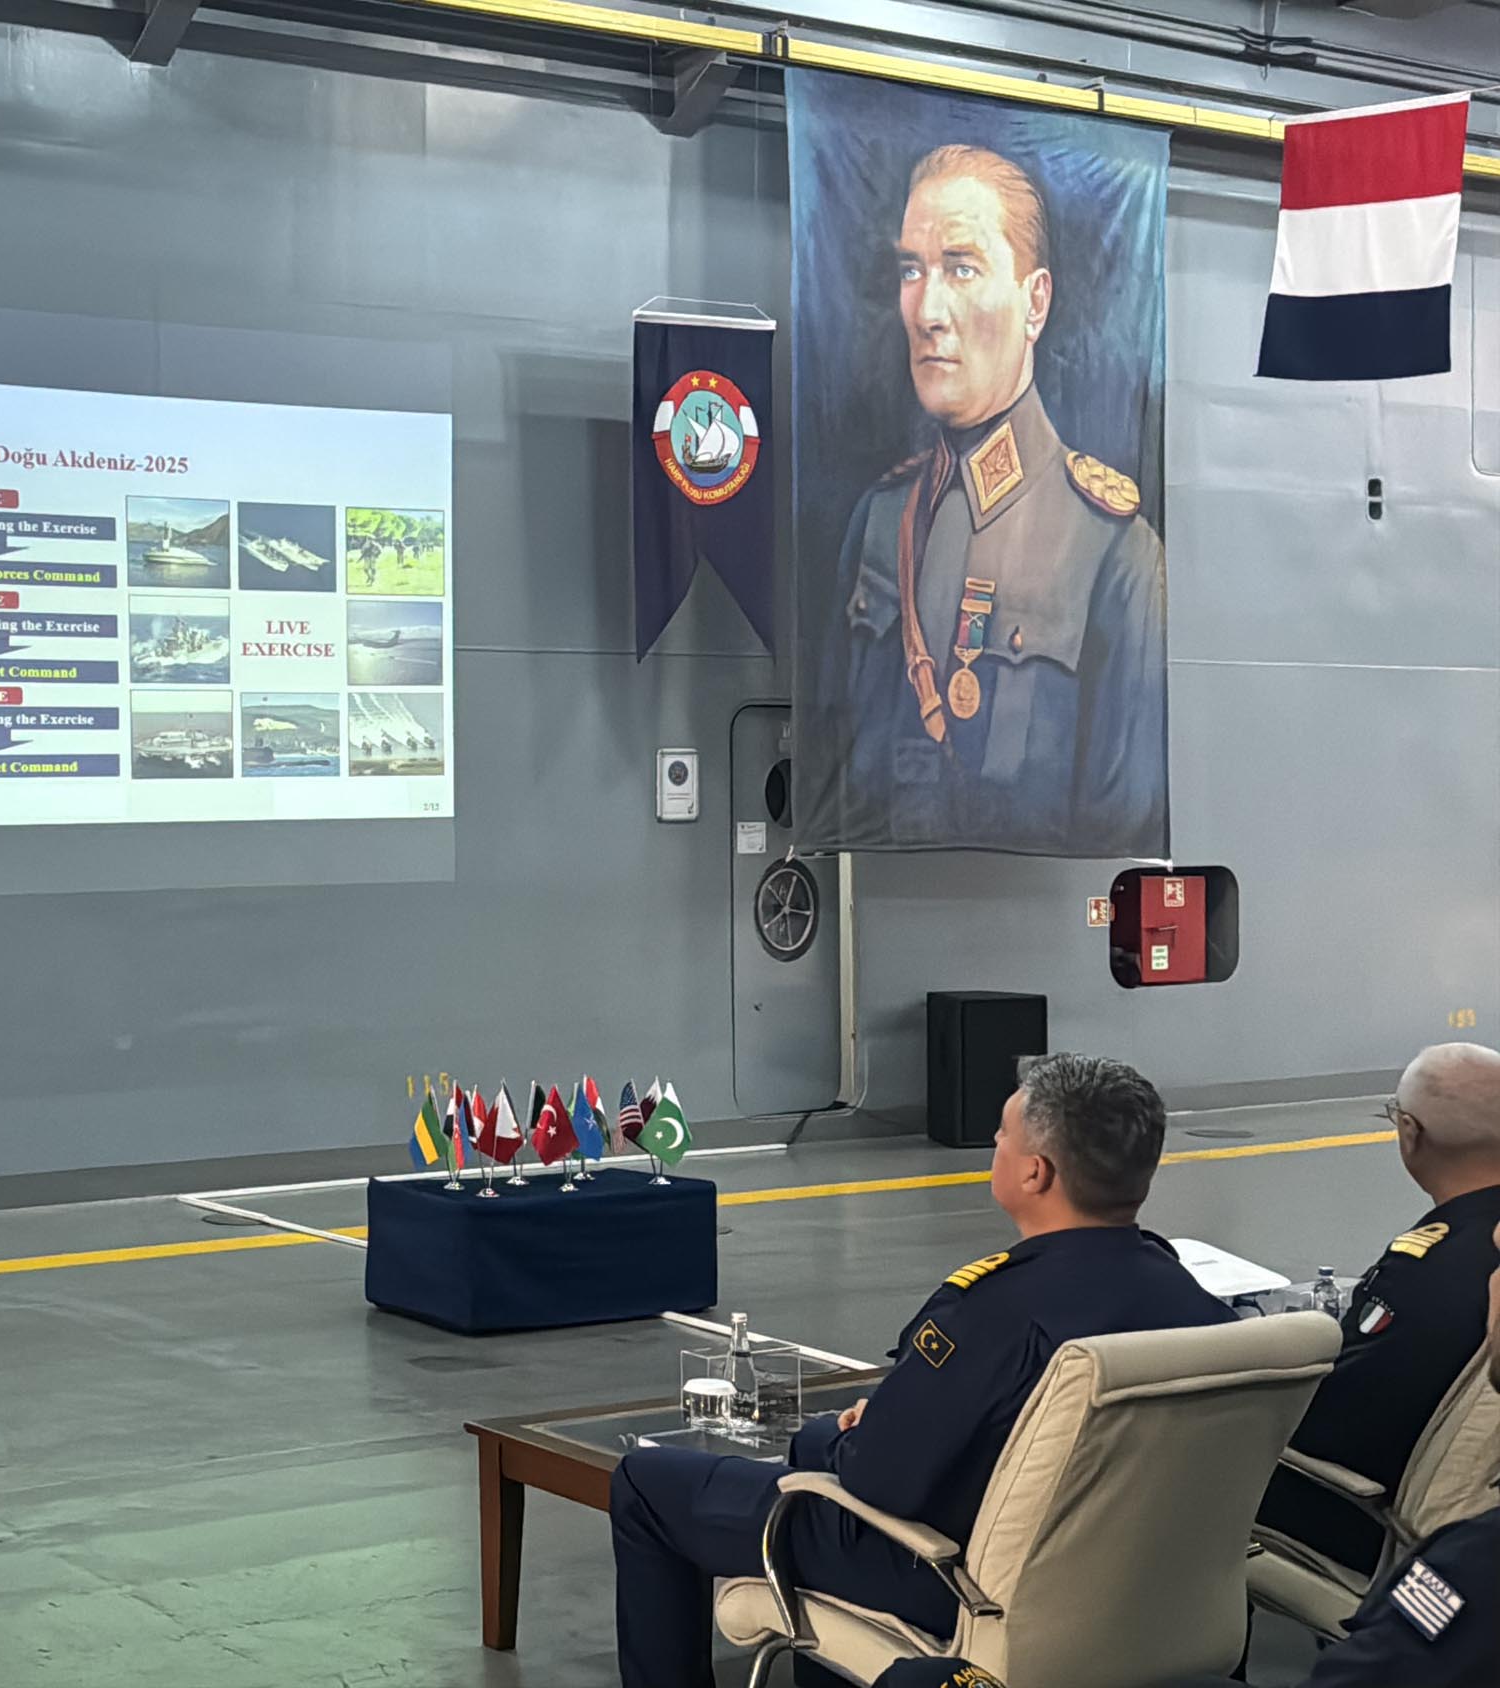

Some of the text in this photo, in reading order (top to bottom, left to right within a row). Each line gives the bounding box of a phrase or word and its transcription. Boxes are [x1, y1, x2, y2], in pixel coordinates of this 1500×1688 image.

[53, 449, 189, 474] Akdeniz-2025
[18, 518, 40, 532] the
[42, 520, 98, 536] Exercise
[33, 568, 100, 583] Command
[21, 619, 42, 632] the
[44, 620, 100, 634] Exercise
[265, 620, 311, 636] LIVE
[241, 642, 336, 658] EXERCISE
[10, 665, 77, 679] Command
[17, 713, 39, 726] the
[42, 714, 95, 726] Exercise
[10, 760, 78, 774] Command
[406, 1072, 450, 1099] 115
